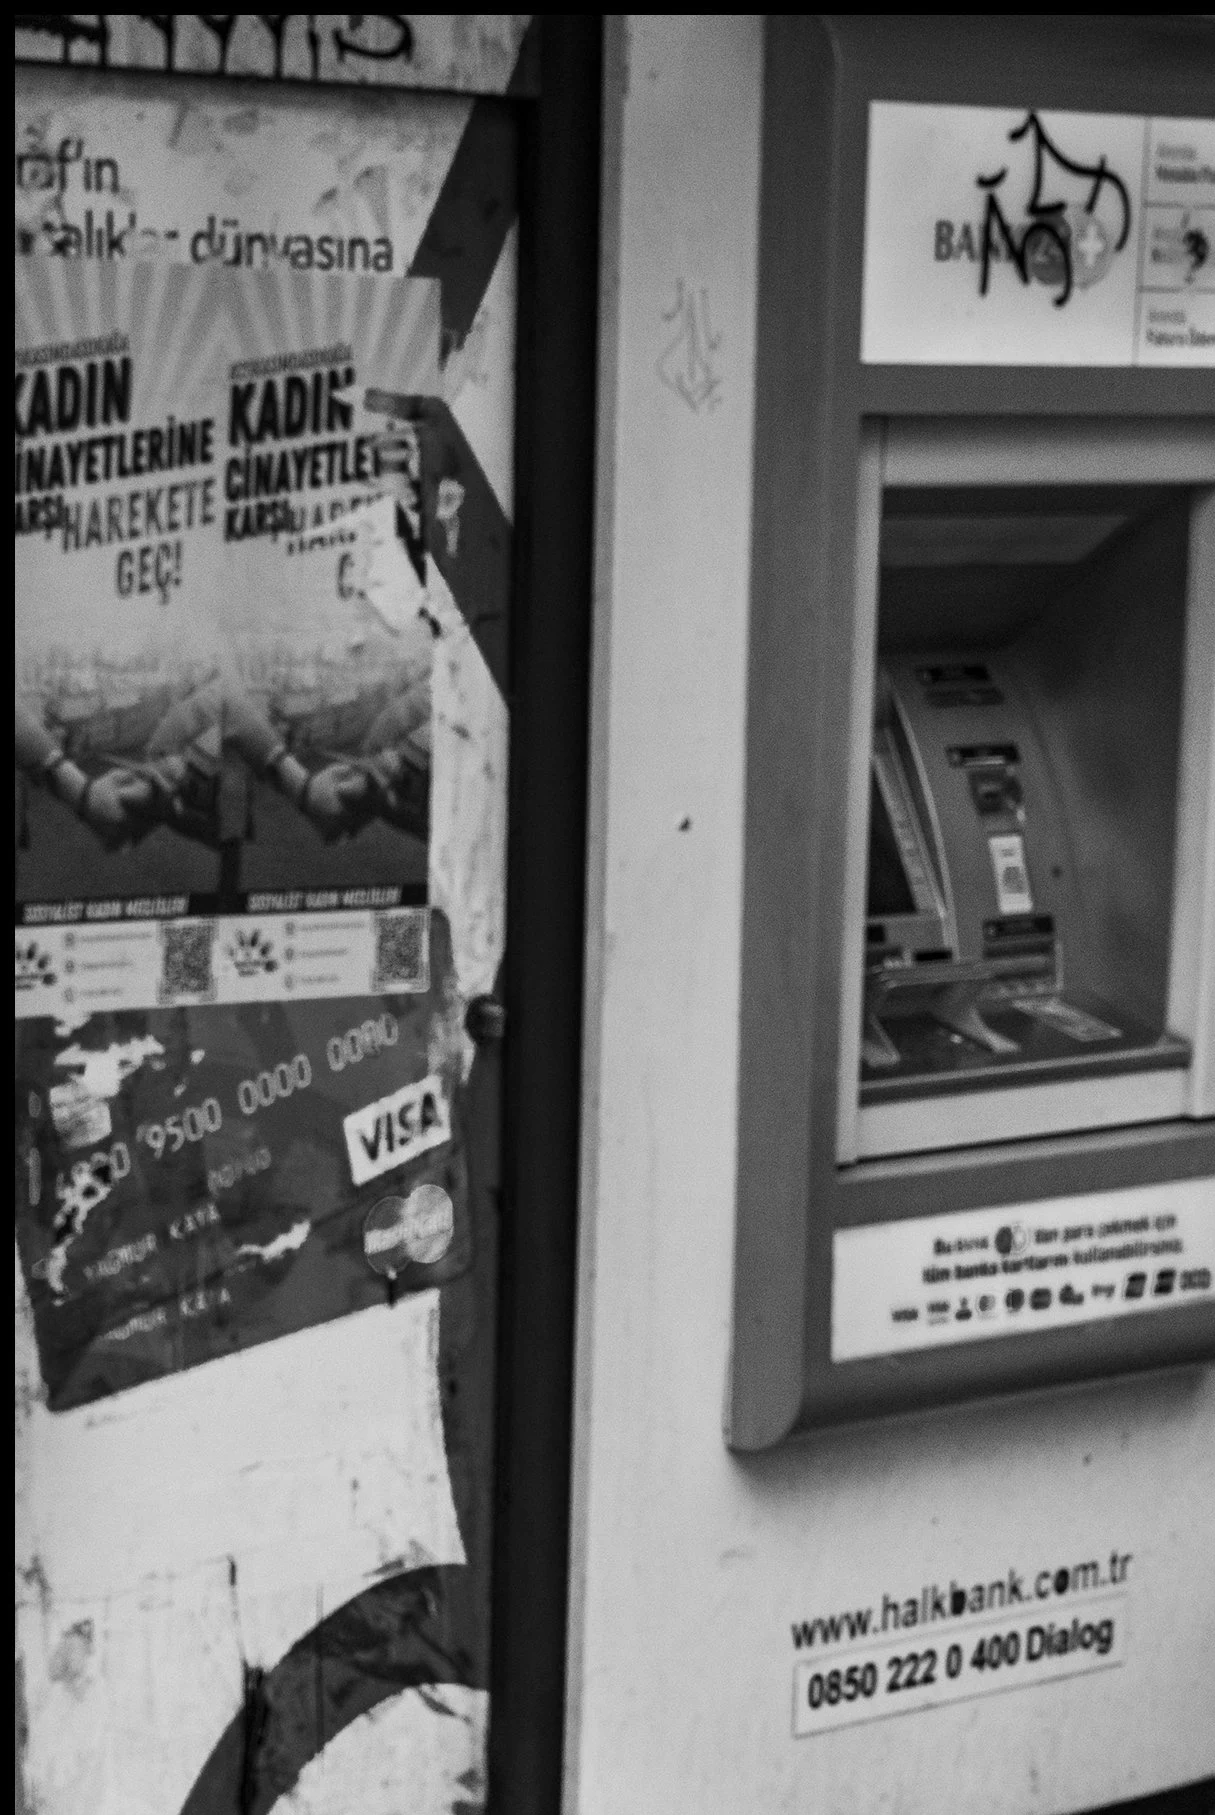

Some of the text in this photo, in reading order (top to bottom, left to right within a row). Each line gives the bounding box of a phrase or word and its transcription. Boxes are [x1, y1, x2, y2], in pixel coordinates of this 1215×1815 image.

[61, 476, 216, 555] HAREKETE
[116, 538, 182, 606] GEÇ!
[237, 1053, 312, 1115] 0000
[358, 1091, 442, 1161] VISA
[790, 1550, 1133, 1650] www.halkbank.com.tr
[807, 1616, 1115, 1711] 0850 222 0 400 Dialog
